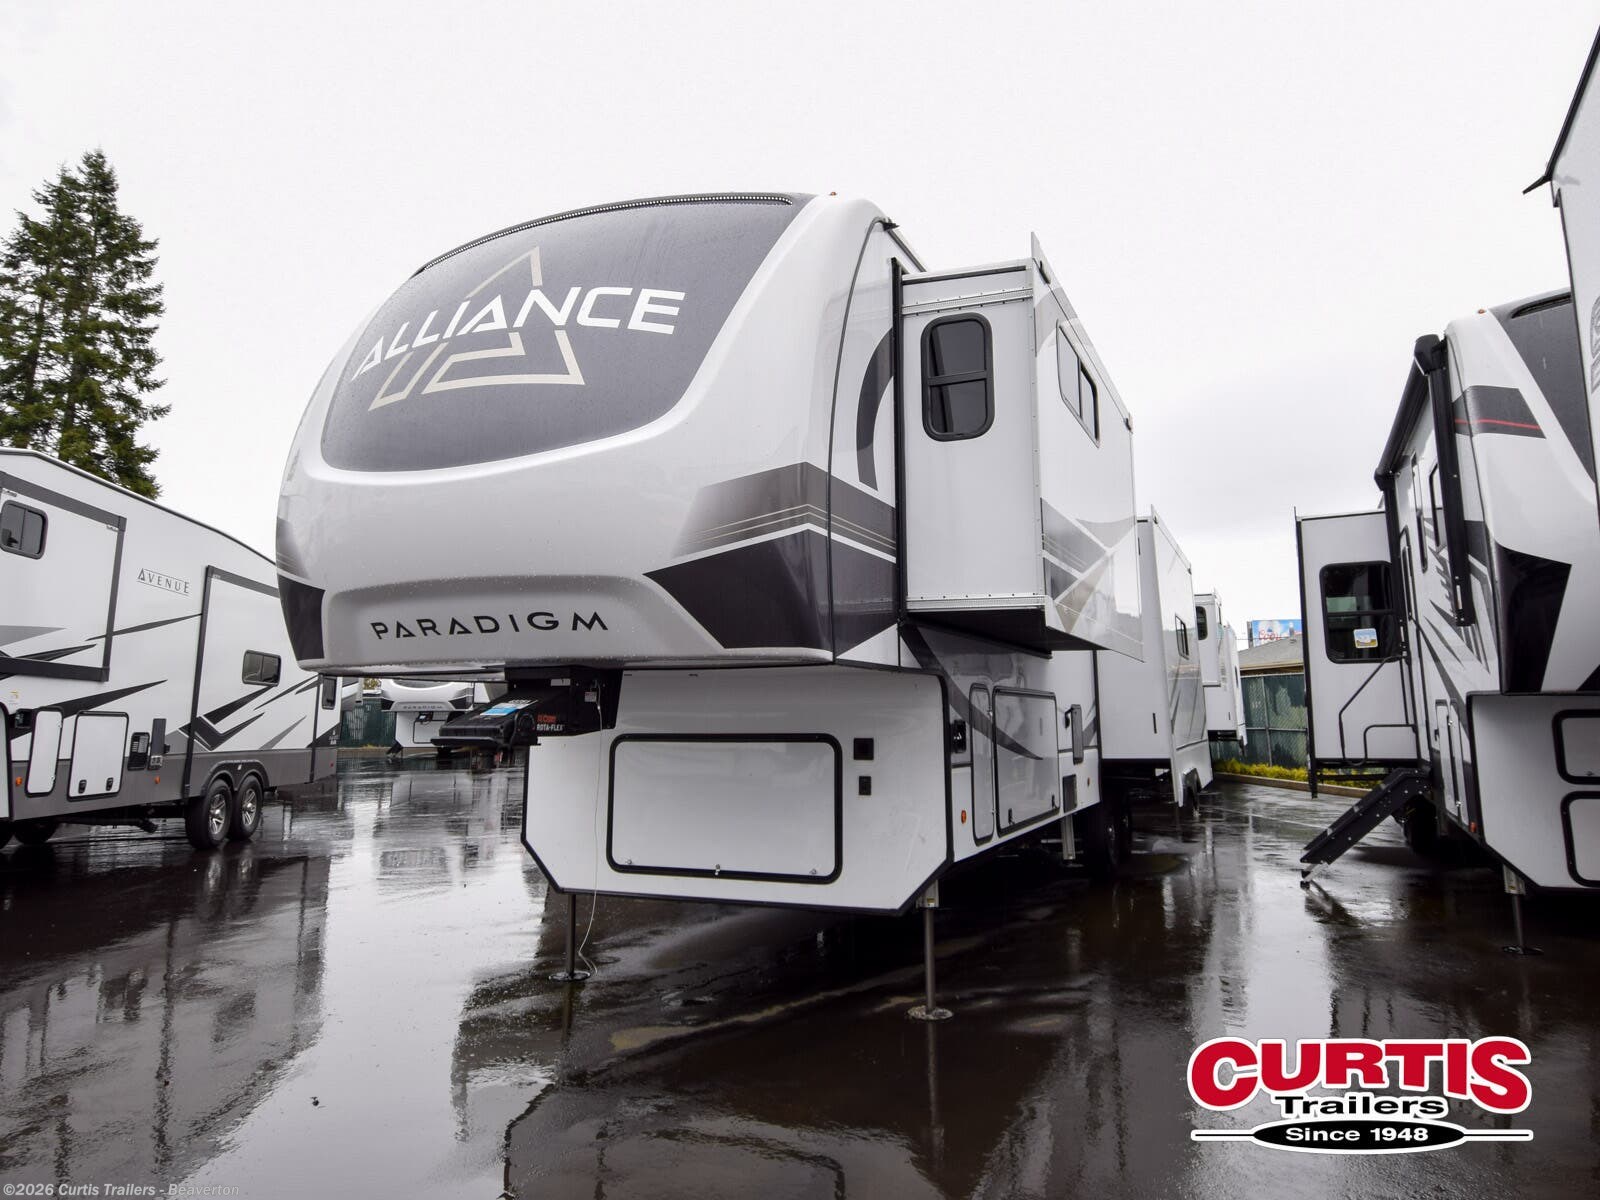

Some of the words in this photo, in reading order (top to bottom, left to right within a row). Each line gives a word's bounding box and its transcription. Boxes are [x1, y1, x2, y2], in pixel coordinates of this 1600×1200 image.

[351, 286, 686, 381] ALLIANCE
[138, 568, 190, 593] AVENUE
[370, 611, 609, 640] PARADIGM
